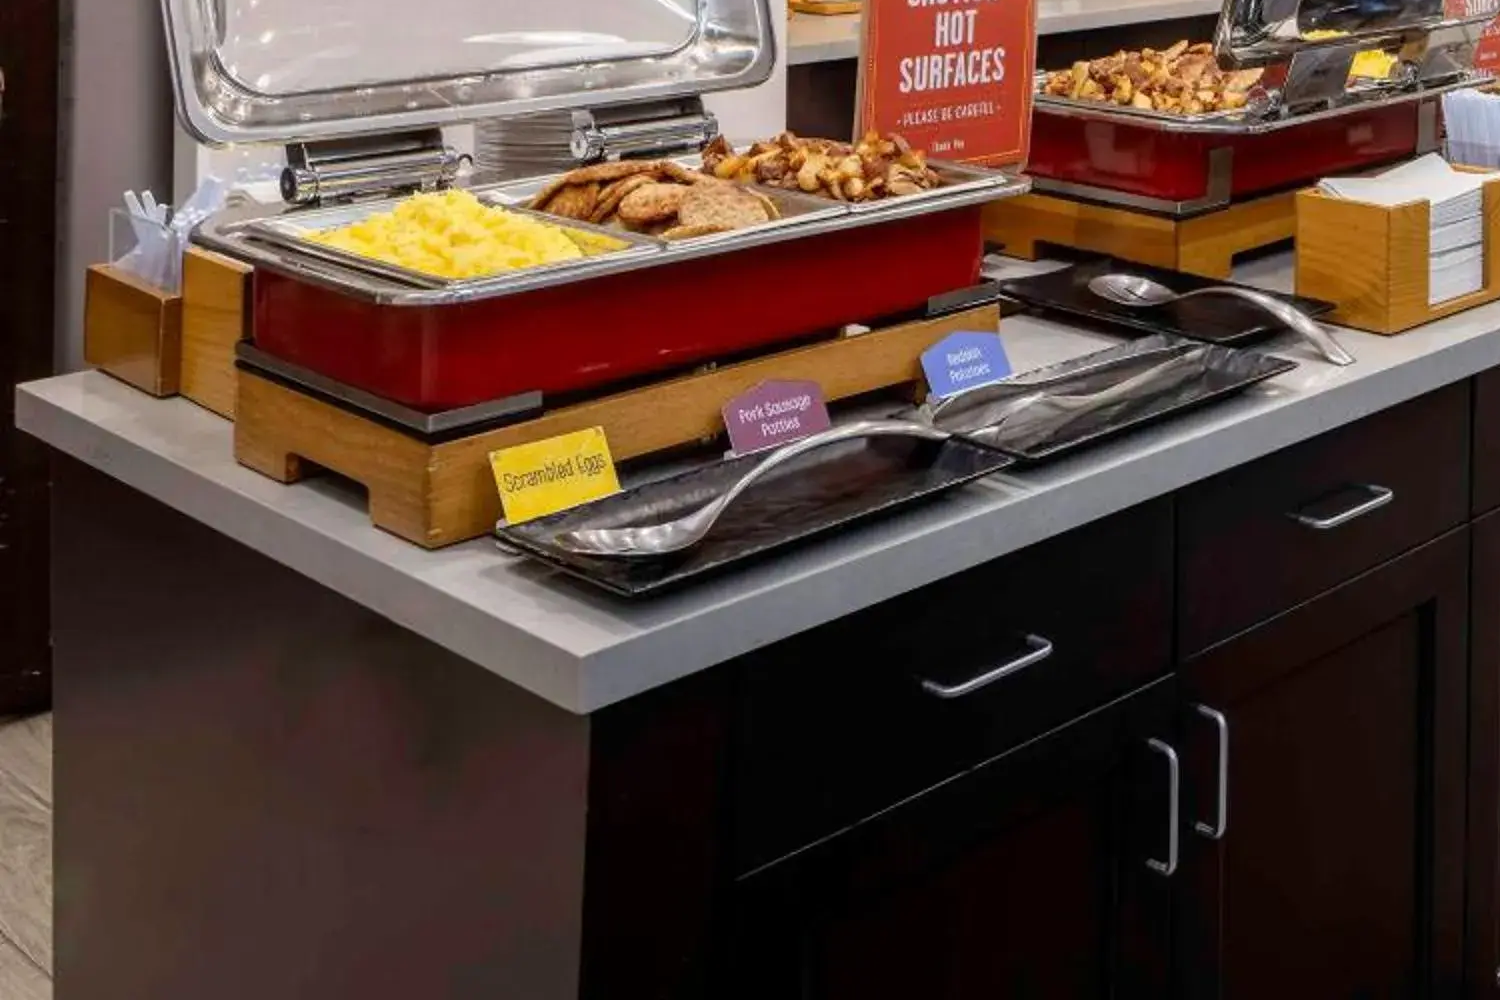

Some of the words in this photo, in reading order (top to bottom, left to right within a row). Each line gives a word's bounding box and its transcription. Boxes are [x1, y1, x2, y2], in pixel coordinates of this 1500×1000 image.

[935, 9, 977, 47] HOT
[899, 47, 1006, 94] SURFACES
[739, 404, 764, 424] Pork
[764, 394, 811, 417] Sausage
[503, 458, 574, 492] Scrambled
[575, 454, 606, 476] Eggs
